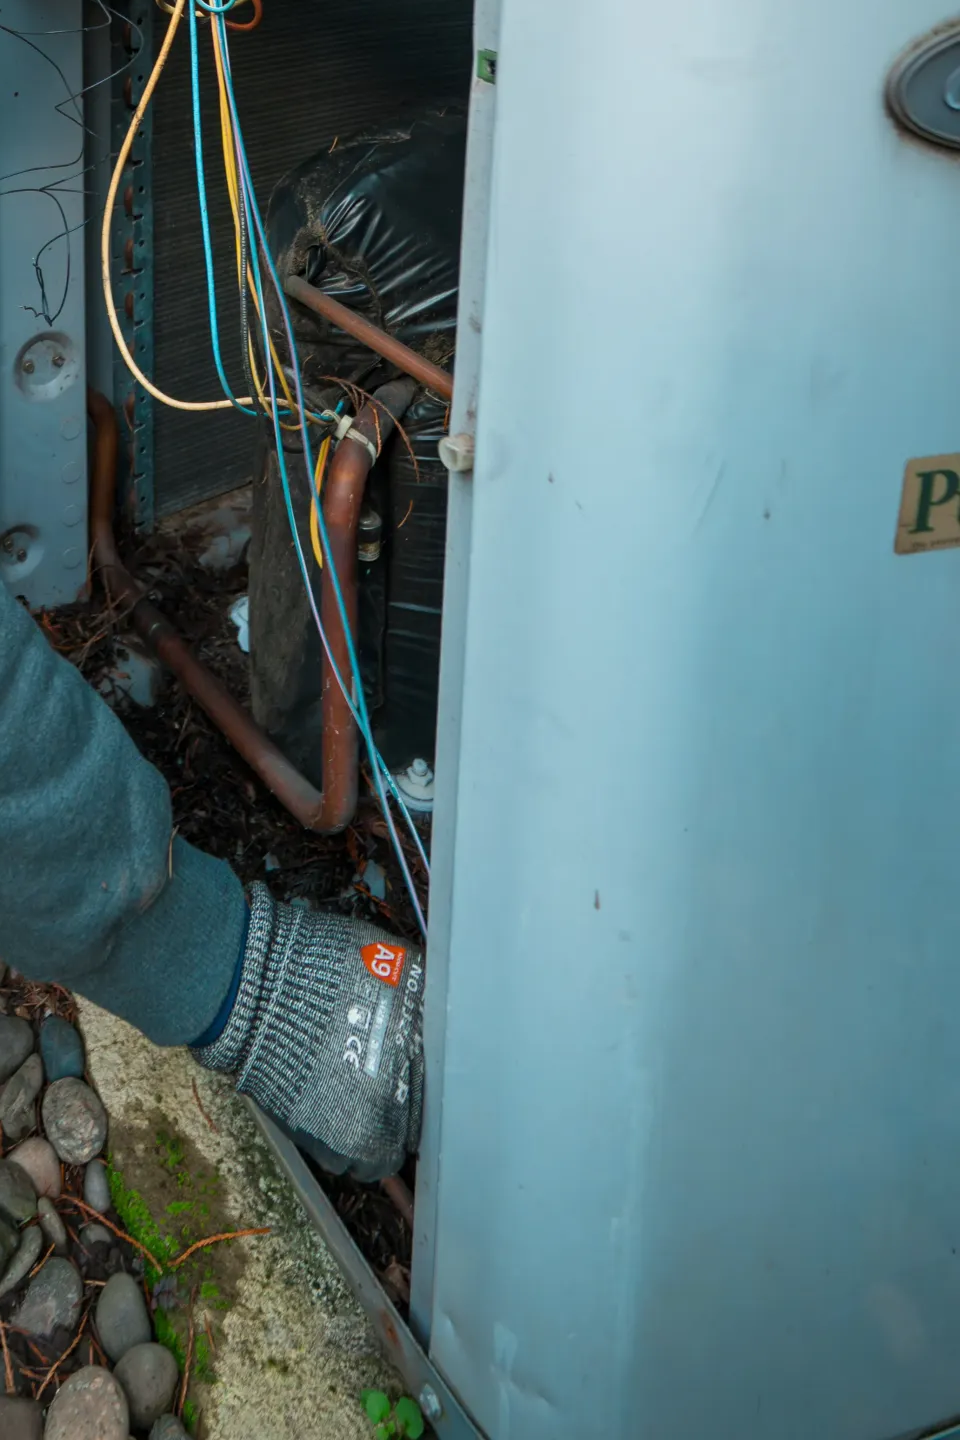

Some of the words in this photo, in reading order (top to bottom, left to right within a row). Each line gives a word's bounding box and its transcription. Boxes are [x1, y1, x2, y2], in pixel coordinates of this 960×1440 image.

[907, 468, 960, 536] P
[371, 943, 395, 977] A9
[343, 1035, 362, 1069] CE
